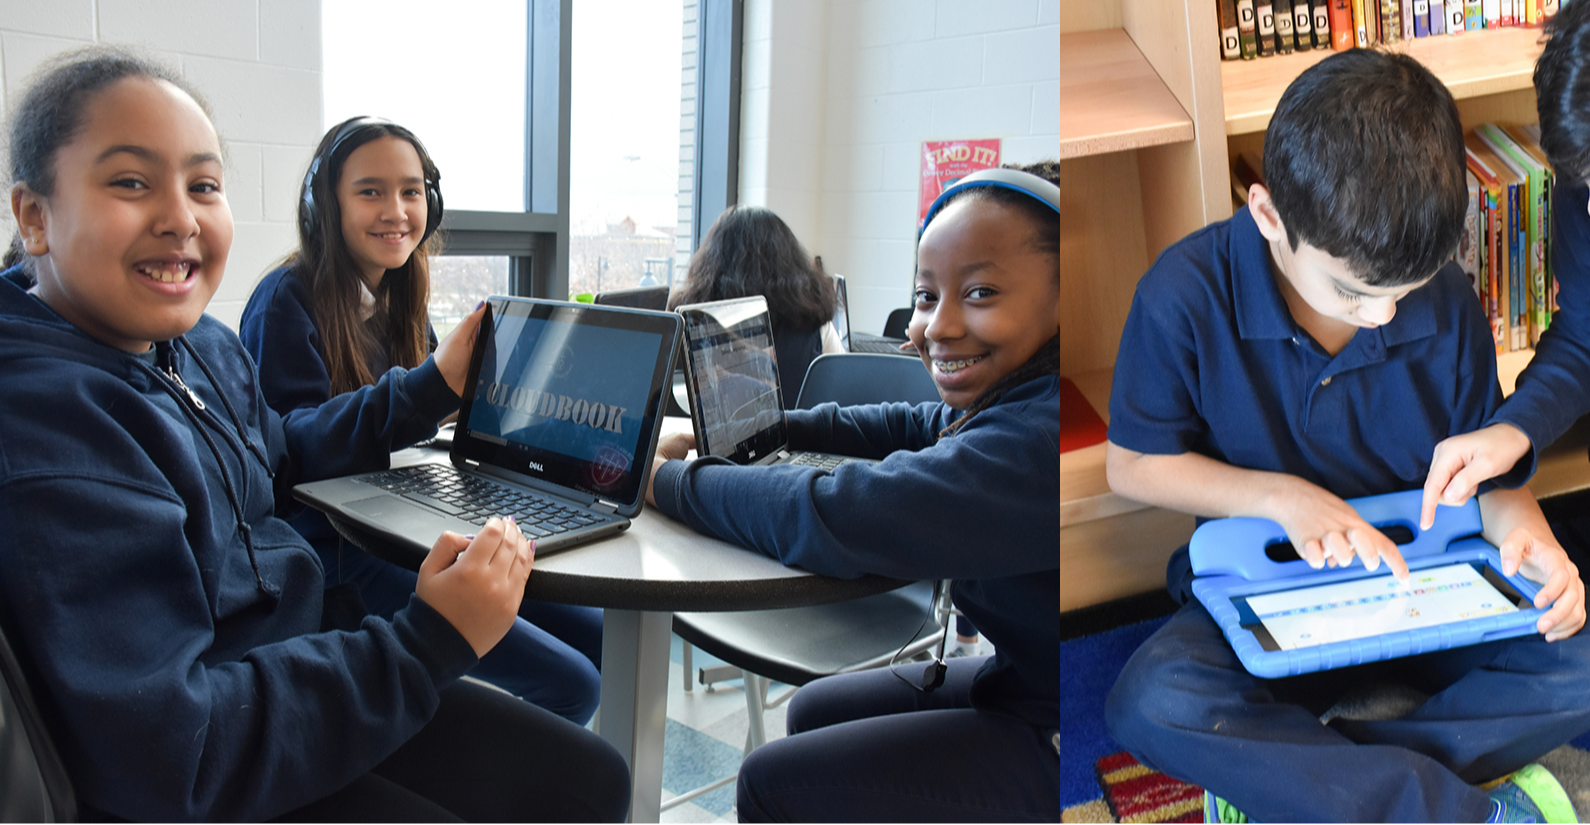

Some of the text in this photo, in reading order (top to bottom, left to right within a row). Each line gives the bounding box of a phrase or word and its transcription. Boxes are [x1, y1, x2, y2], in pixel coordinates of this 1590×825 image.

[1242, 8, 1253, 22] D
[1263, 14, 1274, 28] D
[1297, 14, 1308, 27] D
[1316, 15, 1326, 29] D
[1453, 11, 1463, 26] D
[1226, 36, 1237, 50] D
[925, 146, 997, 169] FIND IT!
[945, 168, 972, 176] Decimal
[486, 381, 627, 434] CLOUDBOOK
[529, 461, 544, 472] DELL
